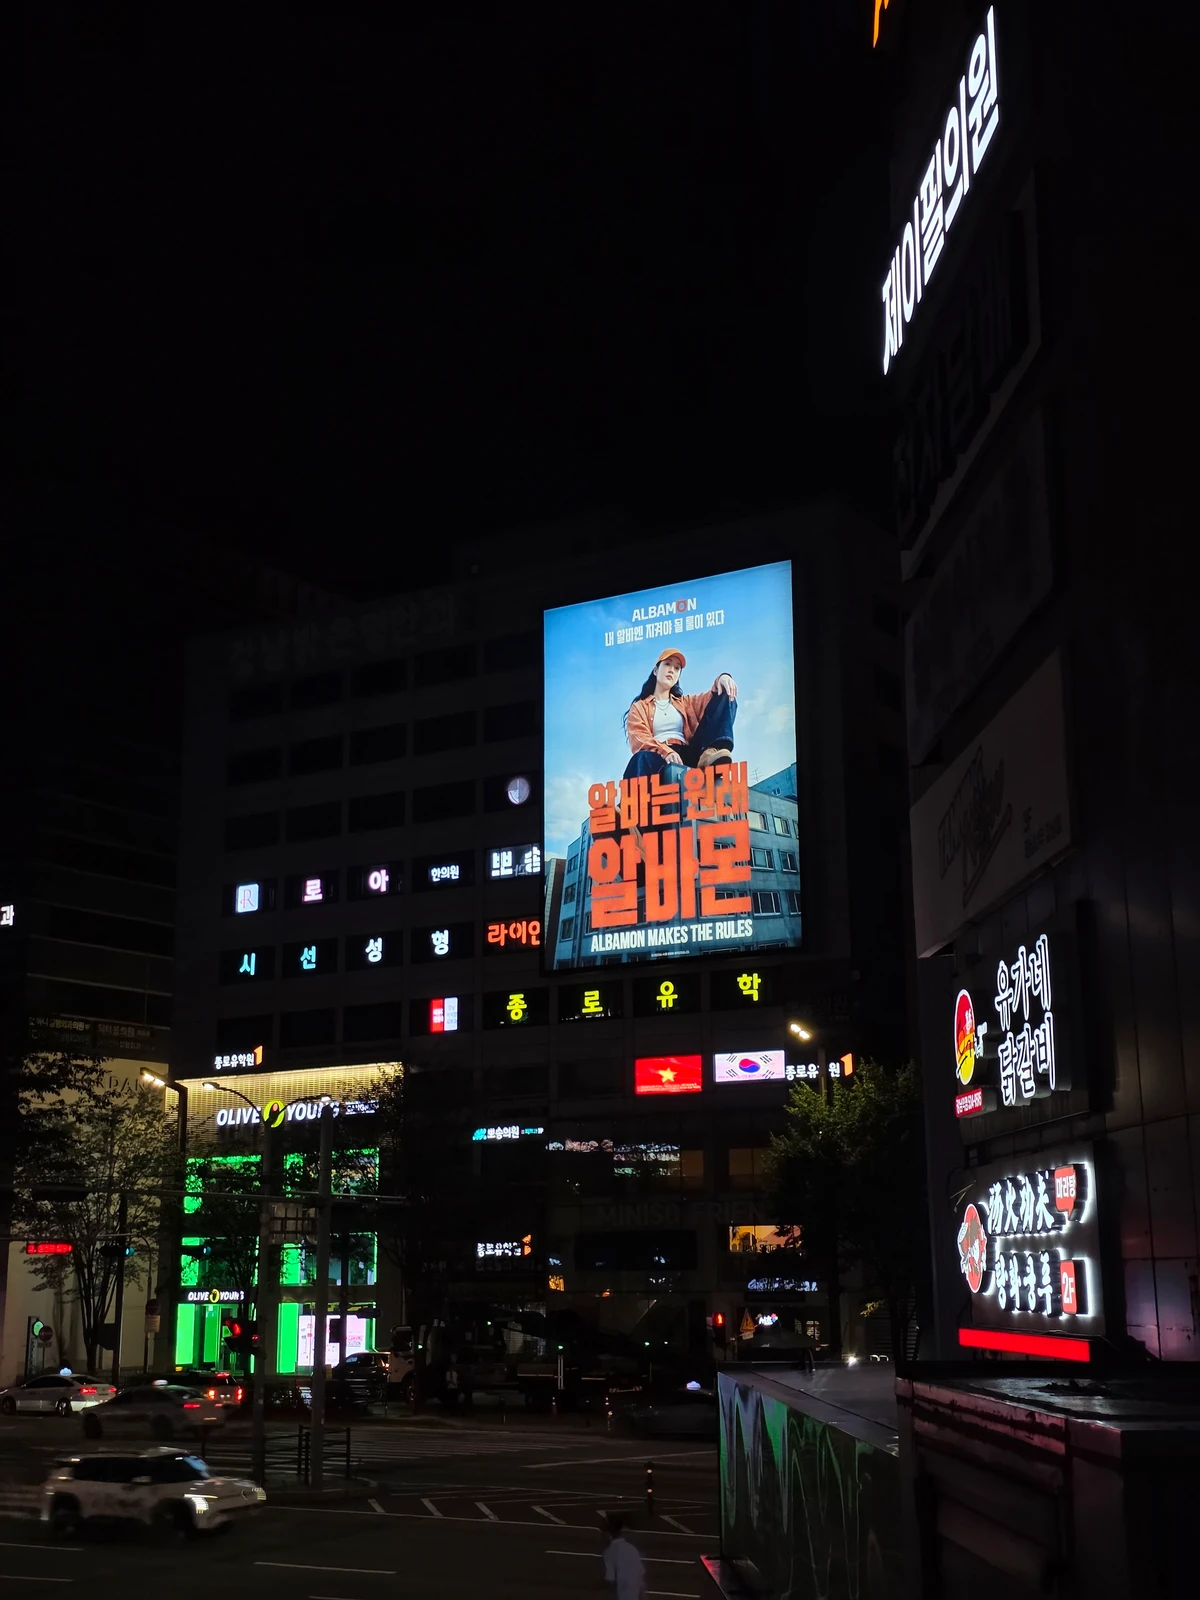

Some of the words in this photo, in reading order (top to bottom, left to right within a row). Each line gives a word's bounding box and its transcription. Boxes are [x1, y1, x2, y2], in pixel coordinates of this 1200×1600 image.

[882, 5, 998, 376] 제이필의원
[632, 597, 697, 622] ALBAMON
[604, 631, 615, 647] 내
[616, 625, 644, 645] 알바엔
[645, 620, 673, 639] 지켜야
[685, 613, 704, 631] 룰이
[705, 609, 725, 627] 있다
[588, 773, 681, 835] 알바는
[684, 761, 749, 821] 원래
[430, 864, 460, 881] 한의원
[587, 819, 752, 929] 알바몬
[590, 929, 647, 953] ALBAMON
[647, 925, 689, 948] MAKES
[689, 922, 713, 942] THE
[715, 919, 753, 940] RULES
[994, 934, 1052, 1031] 유가네
[214, 1053, 254, 1070] 종로유학원
[785, 1061, 840, 1081] 종로유원
[998, 1011, 1056, 1107] 닭갈비
[216, 1106, 262, 1126] OLIVE
[187, 1291, 210, 1301] OLIVE
[994, 1251, 1053, 1315] 탕화쿵푸
[1061, 1271, 1075, 1304] 2F
